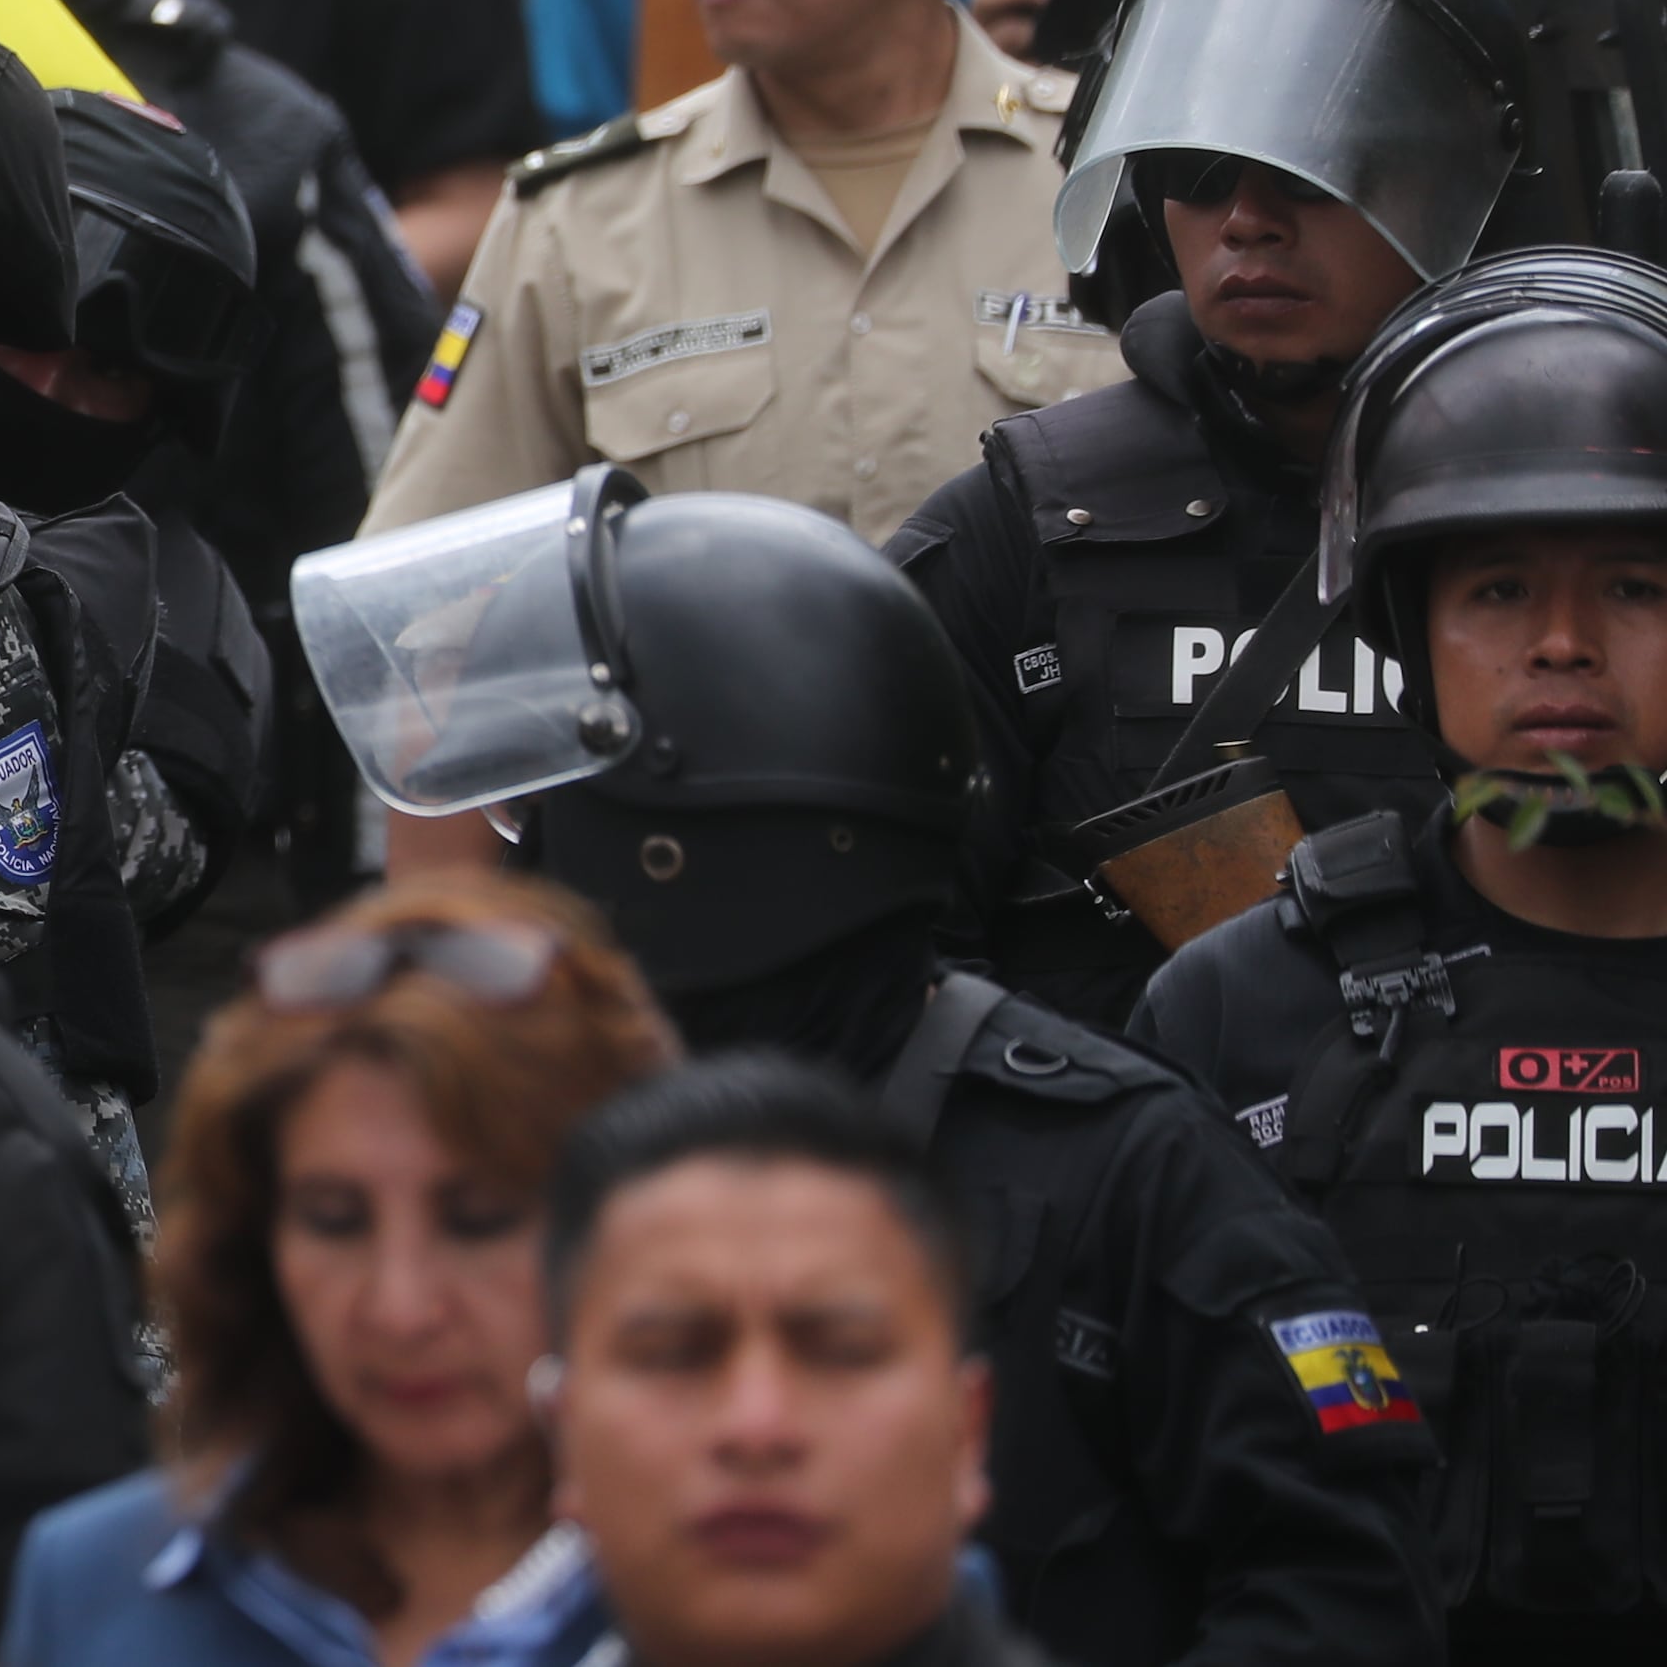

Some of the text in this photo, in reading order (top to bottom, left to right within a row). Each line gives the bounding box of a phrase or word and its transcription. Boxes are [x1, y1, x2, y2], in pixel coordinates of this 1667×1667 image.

[1599, 1076, 1633, 1089] POS
[1423, 1102, 1667, 1184] POLICI
[1280, 1317, 1374, 1348] ECUADOR
